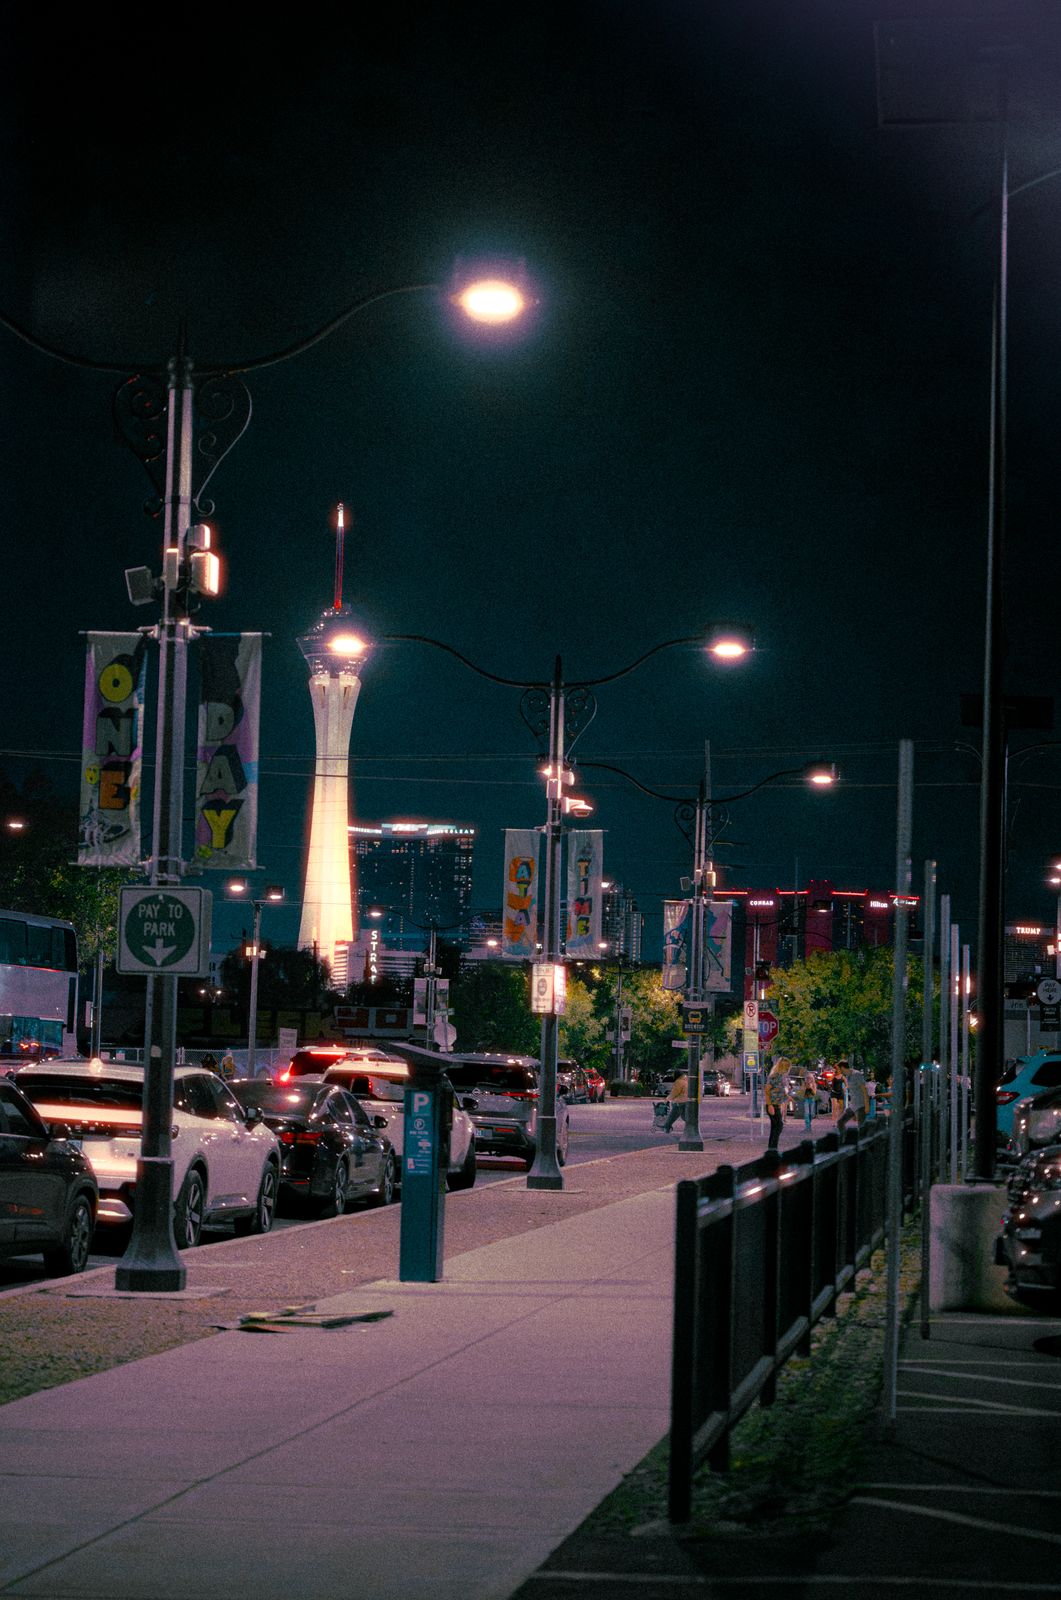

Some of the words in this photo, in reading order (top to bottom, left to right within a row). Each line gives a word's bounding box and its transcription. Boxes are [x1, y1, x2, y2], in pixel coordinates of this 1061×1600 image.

[96, 660, 135, 811] ONE
[200, 700, 246, 849] DAY
[574, 858, 593, 936] TIME
[870, 900, 888, 908] Hilton
[138, 904, 160, 919] PAY
[168, 904, 184, 919] TO
[143, 922, 176, 937] PARK
[1016, 926, 1041, 935] TRUMP
[369, 930, 379, 985] STRAT
[758, 1021, 777, 1034] TOP
